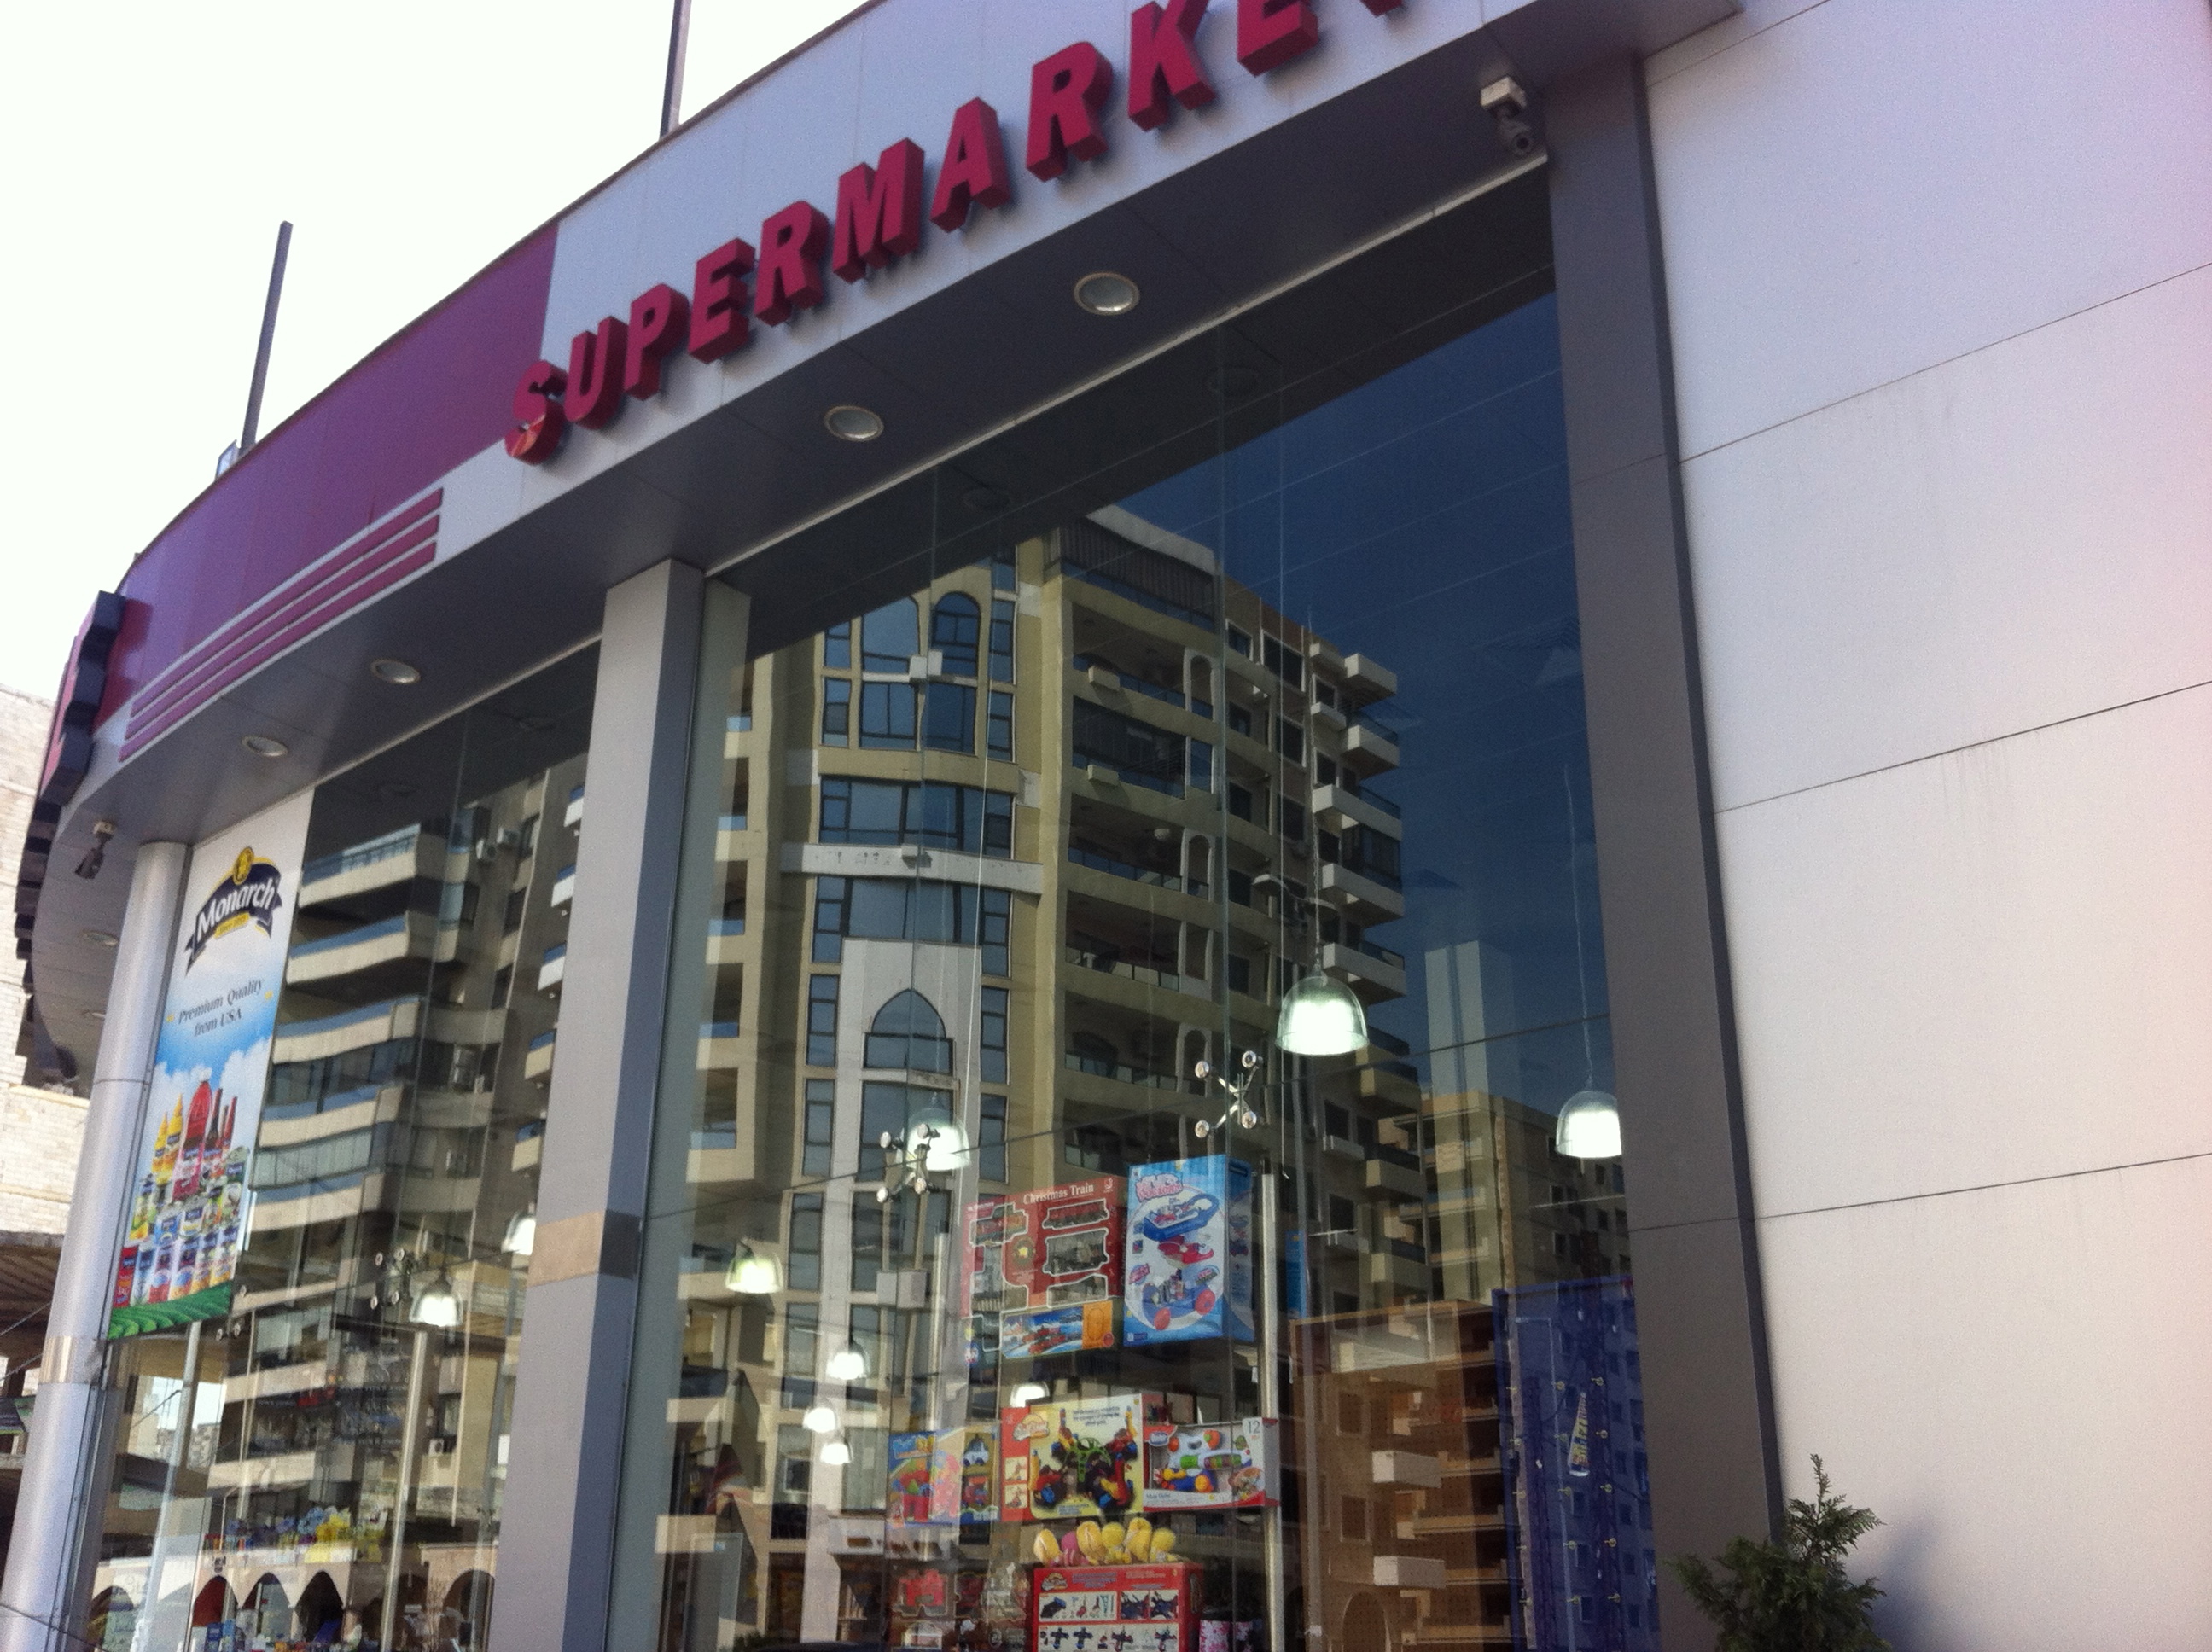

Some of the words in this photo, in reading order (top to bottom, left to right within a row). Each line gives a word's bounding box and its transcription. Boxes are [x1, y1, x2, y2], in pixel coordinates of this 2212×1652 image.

[504, 0, 1402, 466] SUPERMARKE
[196, 877, 276, 941] Monarch
[178, 993, 224, 1024] Premium
[226, 979, 264, 1005] Quality
[194, 1015, 218, 1038] from
[219, 1007, 242, 1028] USA
[1022, 1190, 1068, 1205] Christmas
[1069, 1182, 1094, 1196] Train
[1248, 1420, 1261, 1434] 12
